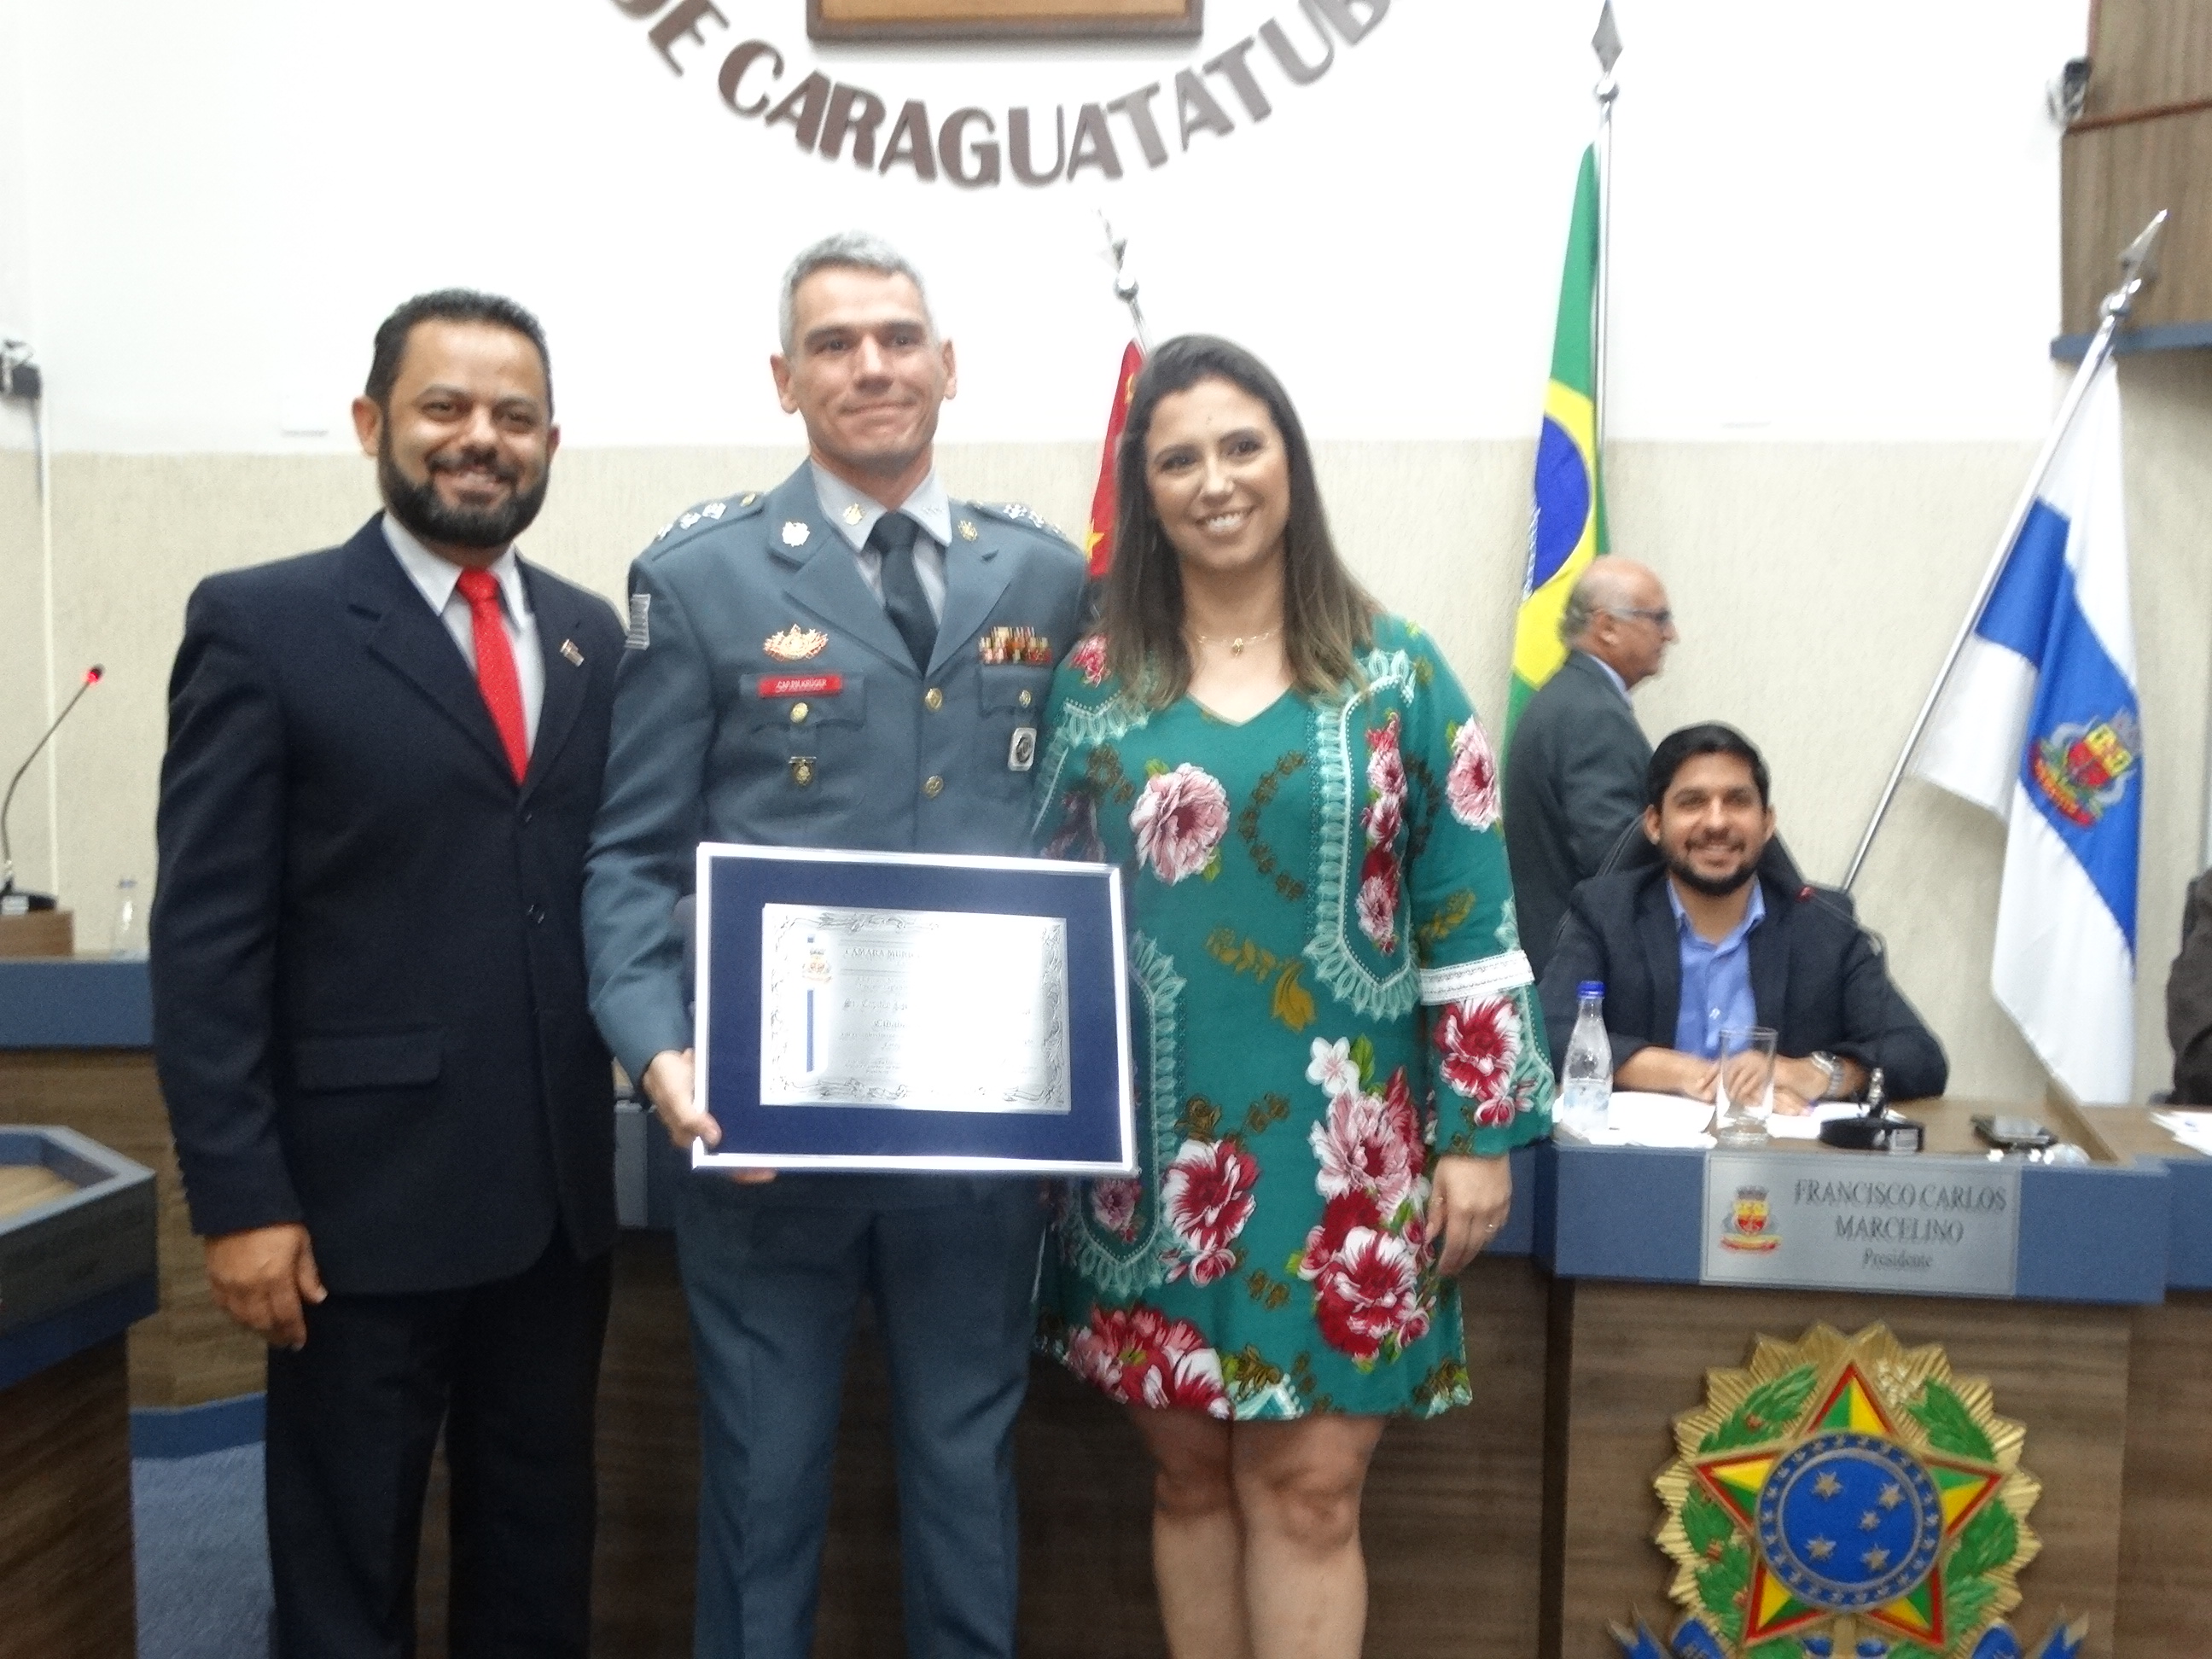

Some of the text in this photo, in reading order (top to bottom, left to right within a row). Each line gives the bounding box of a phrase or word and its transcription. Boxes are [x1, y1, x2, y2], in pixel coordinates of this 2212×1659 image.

[608, 0, 731, 77] E
[1794, 1178, 2007, 1213] FRANCISCO CARLOS
[1835, 1214, 1964, 1244] MARCELINO
[1861, 1247, 1934, 1270] Presidente
